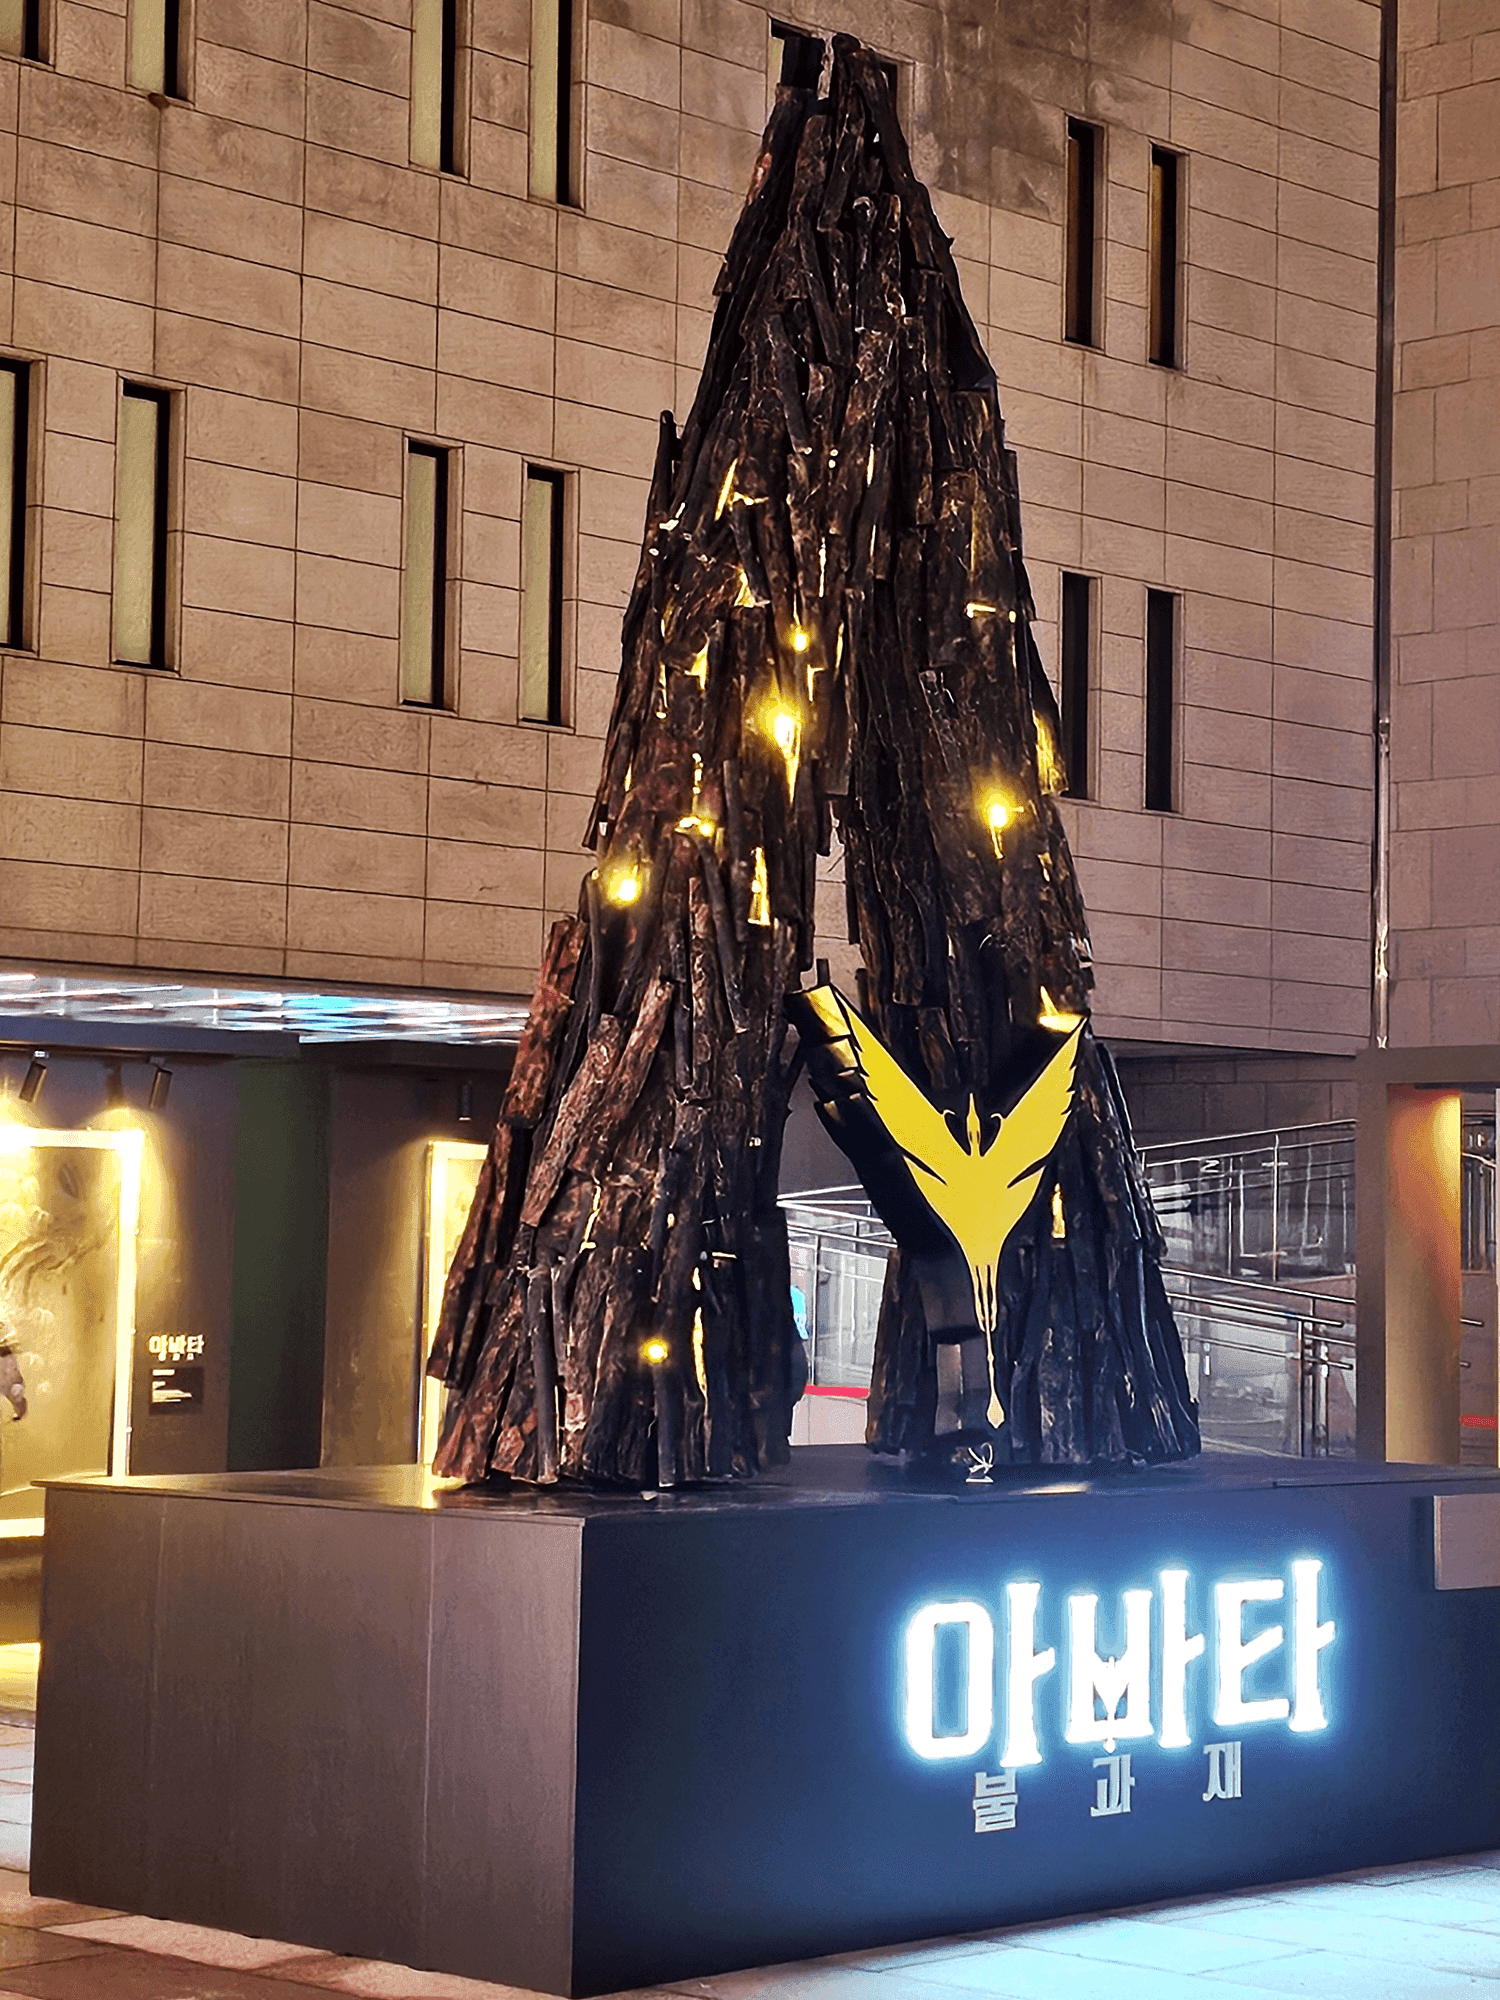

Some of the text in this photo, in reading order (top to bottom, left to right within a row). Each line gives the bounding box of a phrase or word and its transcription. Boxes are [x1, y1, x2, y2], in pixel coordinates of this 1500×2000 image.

[906, 1559, 1336, 1767] 아바타
[973, 1741, 1242, 1833] 불 과 재
